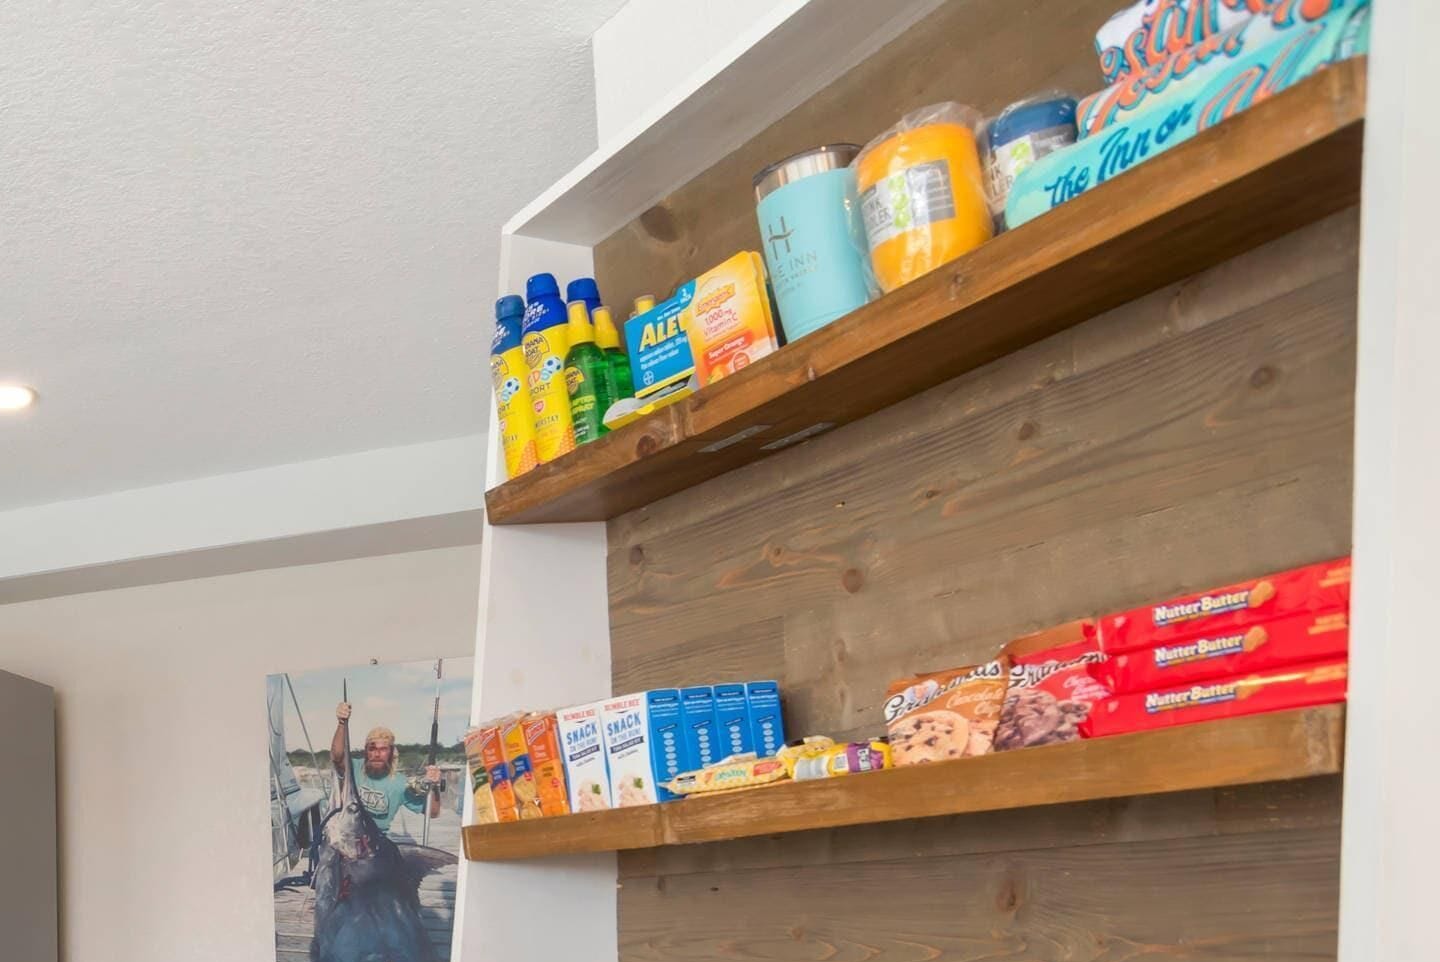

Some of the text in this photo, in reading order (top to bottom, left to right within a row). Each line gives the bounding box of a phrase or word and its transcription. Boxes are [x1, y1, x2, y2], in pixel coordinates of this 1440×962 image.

[1154, 591, 1249, 622] Nutter Butter
[1154, 634, 1243, 663] Nutter Butter
[1145, 683, 1236, 708] Nutter Butter
[566, 722, 598, 746] SNACK
[606, 712, 642, 736] SNACK
